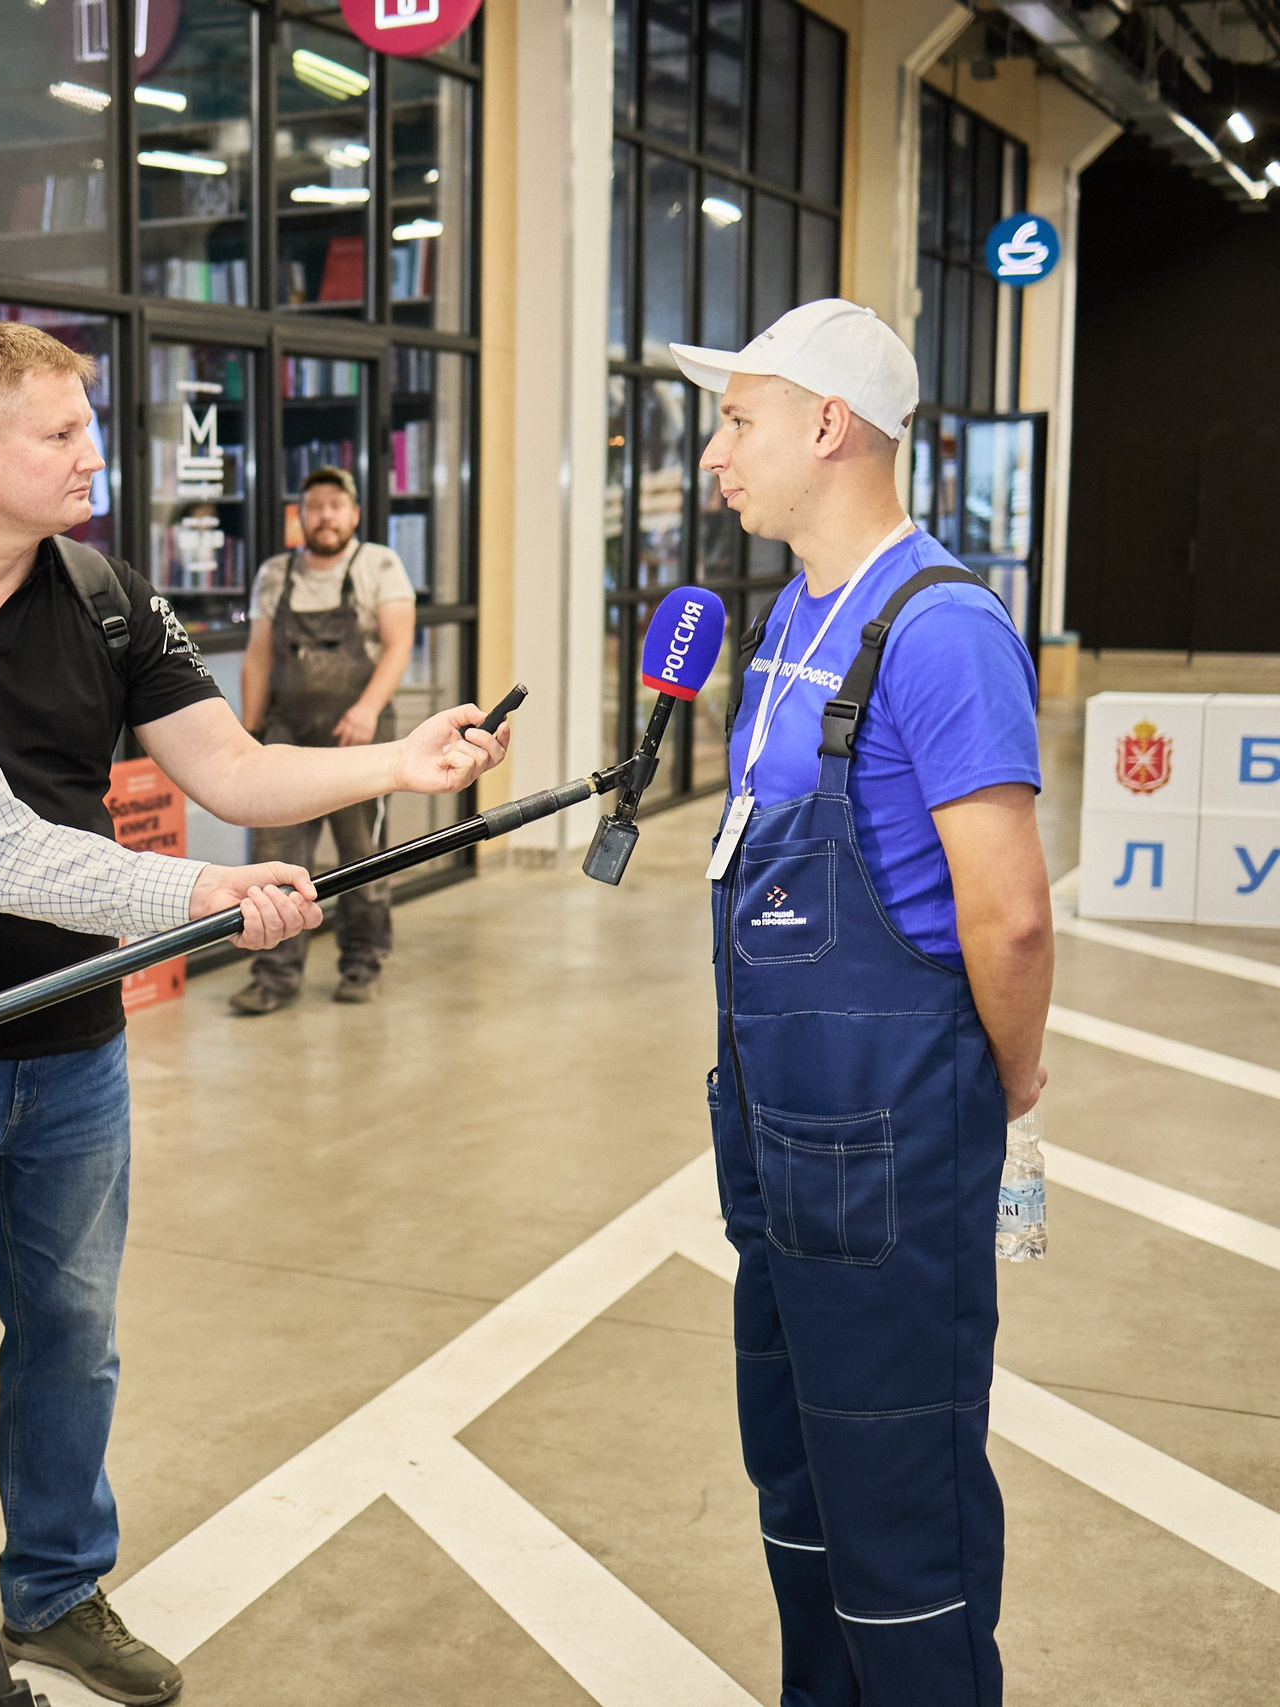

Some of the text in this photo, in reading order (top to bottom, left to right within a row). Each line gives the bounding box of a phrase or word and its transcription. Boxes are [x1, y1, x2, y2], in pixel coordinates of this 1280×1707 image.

[661, 600, 704, 683] РОССИЯ
[761, 909, 795, 919] ЛУЧШИЙ
[750, 917, 807, 927] ПО ПРОФЕССИИ
[997, 1203, 1019, 1217] UKI
